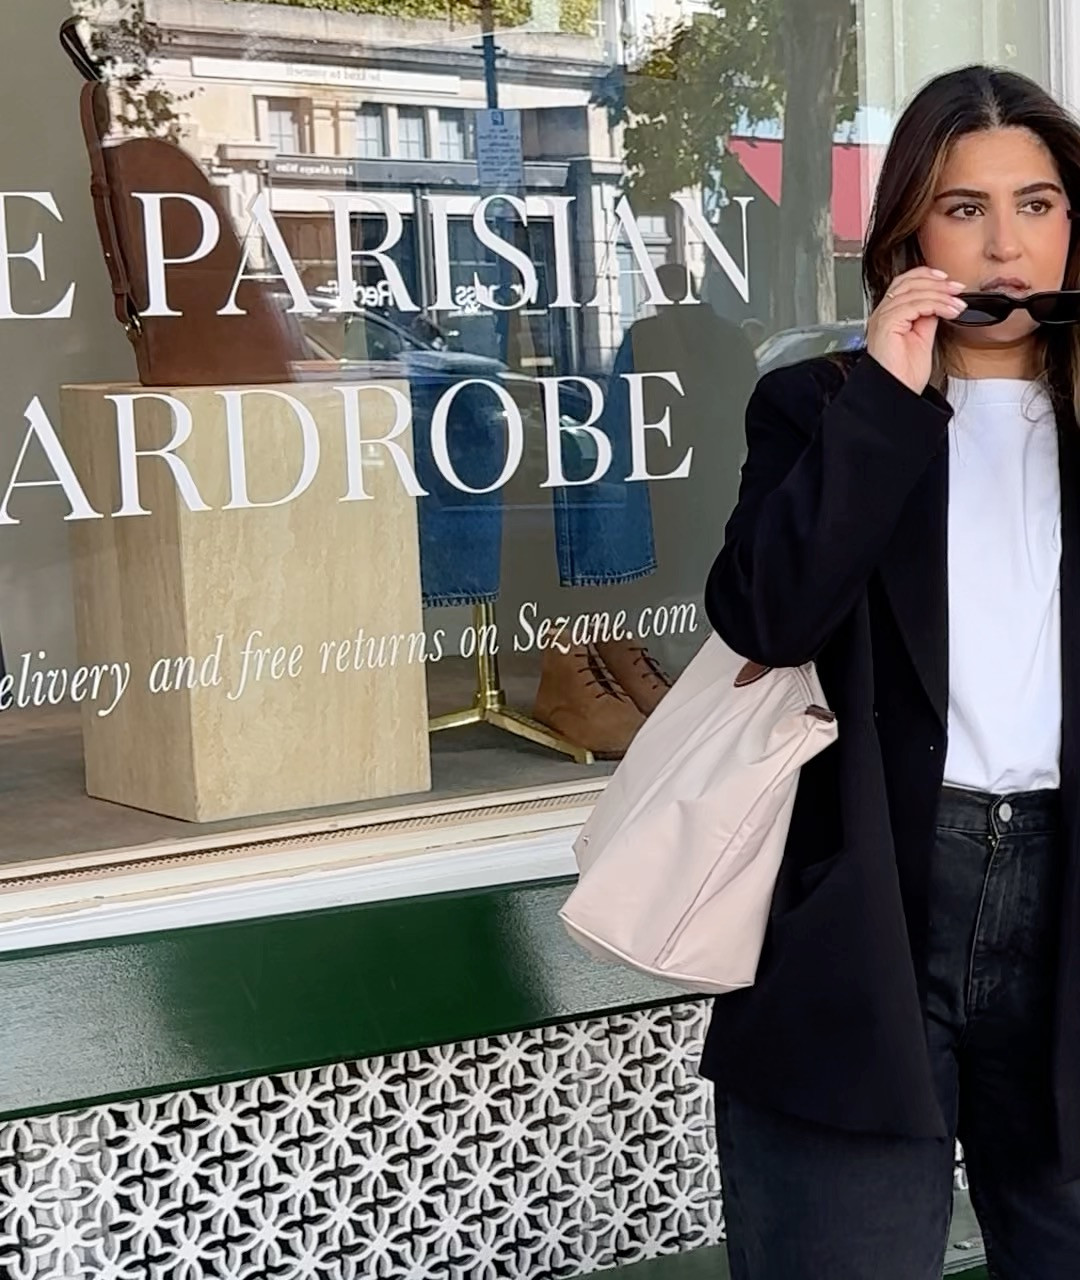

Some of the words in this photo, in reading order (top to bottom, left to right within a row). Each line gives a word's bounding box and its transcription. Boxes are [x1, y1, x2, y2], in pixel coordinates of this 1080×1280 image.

[131, 191, 755, 316] PARISIAN
[0, 371, 694, 524] ARDROBE
[149, 633, 225, 694] and
[227, 630, 304, 701] free
[318, 628, 445, 674] returns
[460, 623, 500, 658] on
[513, 601, 699, 654] Sezane.com
